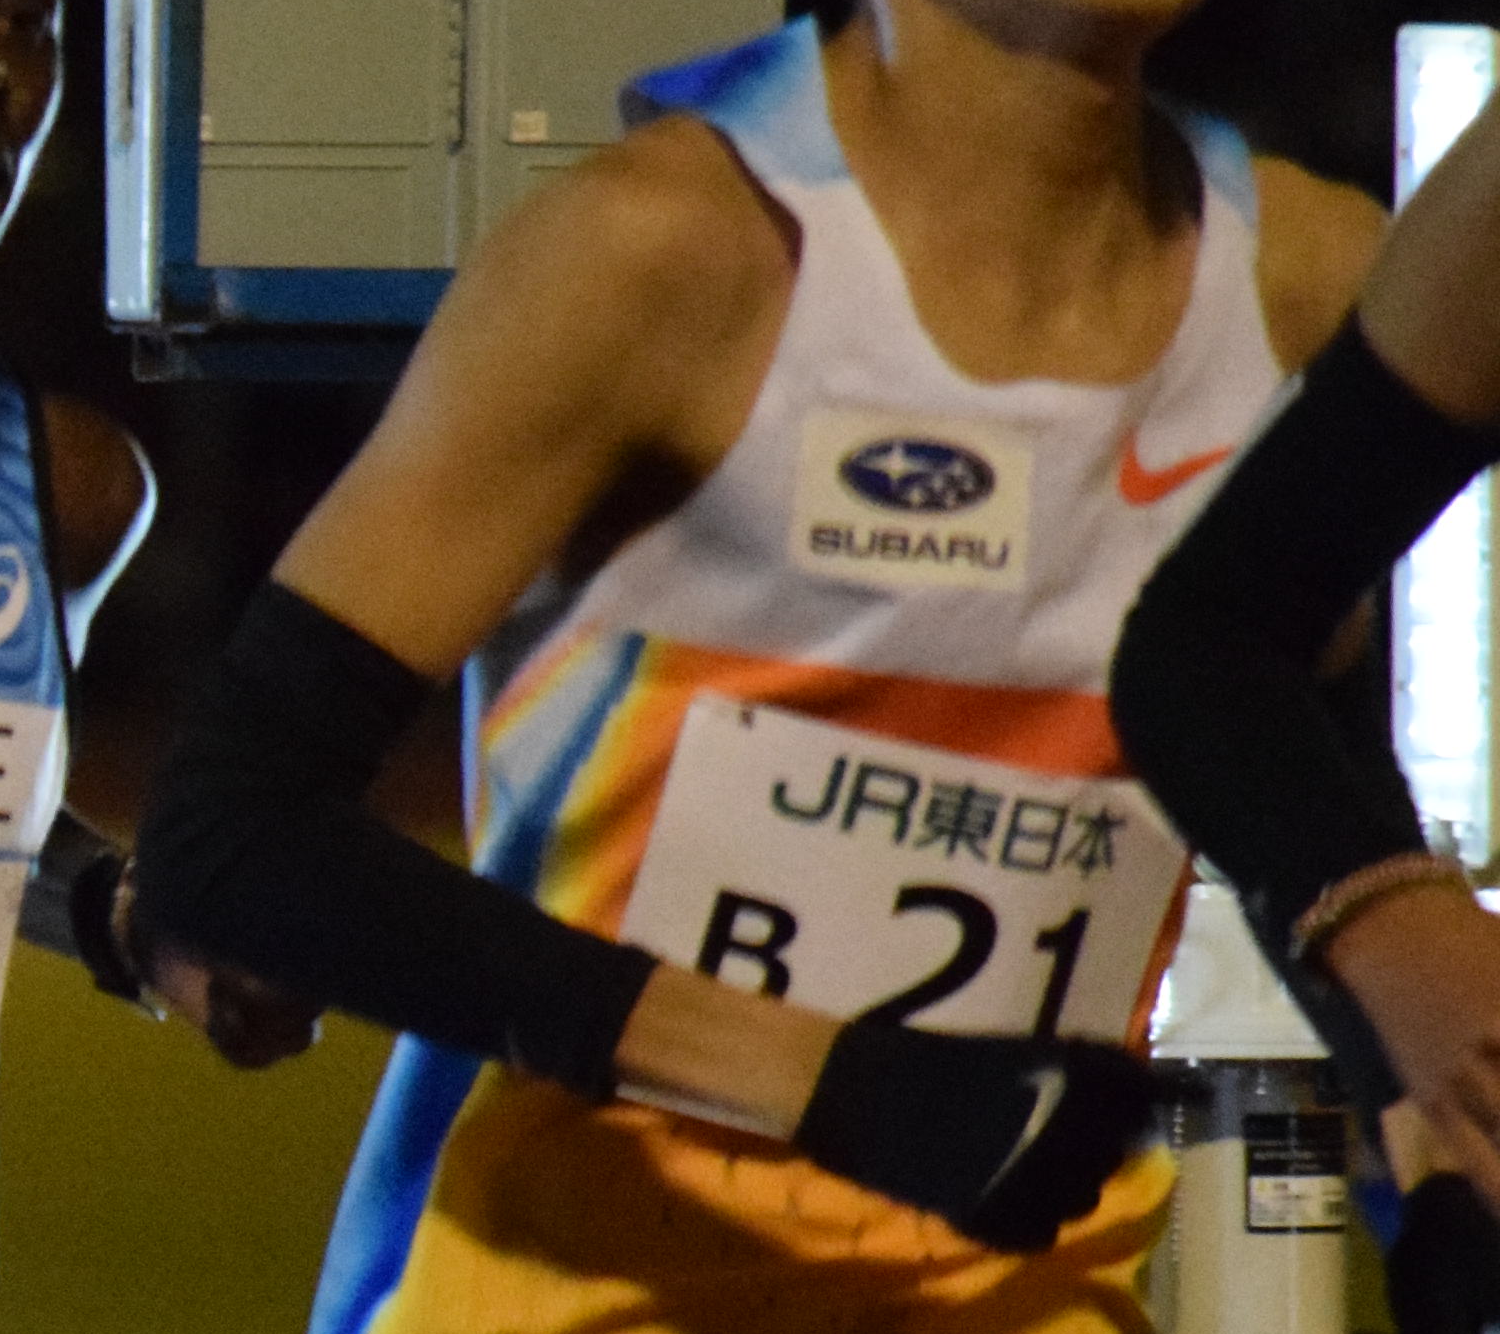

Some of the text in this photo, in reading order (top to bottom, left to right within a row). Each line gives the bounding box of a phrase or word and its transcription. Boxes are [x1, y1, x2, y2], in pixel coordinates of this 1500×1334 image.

[810, 524, 1009, 571] SUBARU
[771, 755, 1128, 880] JR東日本
[845, 883, 1091, 1040] 21
